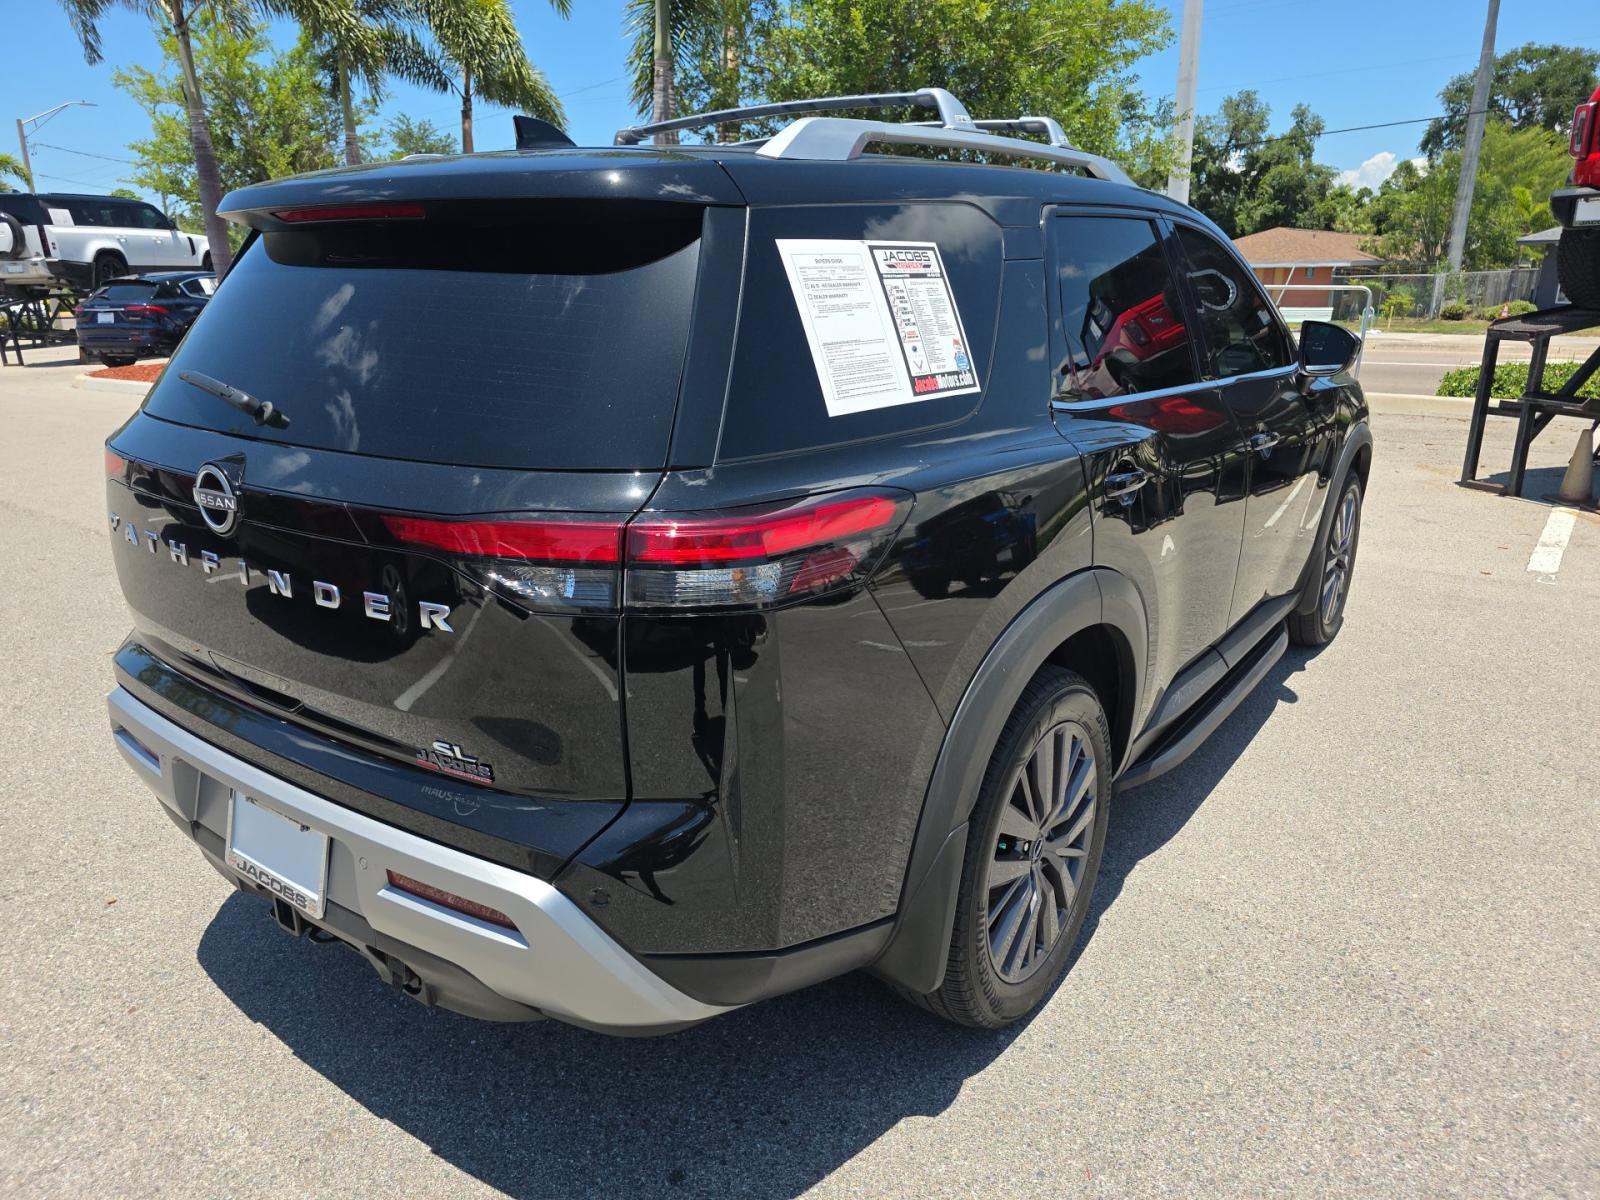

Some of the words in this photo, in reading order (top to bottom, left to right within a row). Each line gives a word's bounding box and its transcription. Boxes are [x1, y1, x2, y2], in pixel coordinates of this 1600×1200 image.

[883, 251, 931, 262] JACOBS
[109, 511, 455, 633] PATHFINDER
[432, 740, 480, 763] SL
[236, 860, 308, 909] JACOBS
